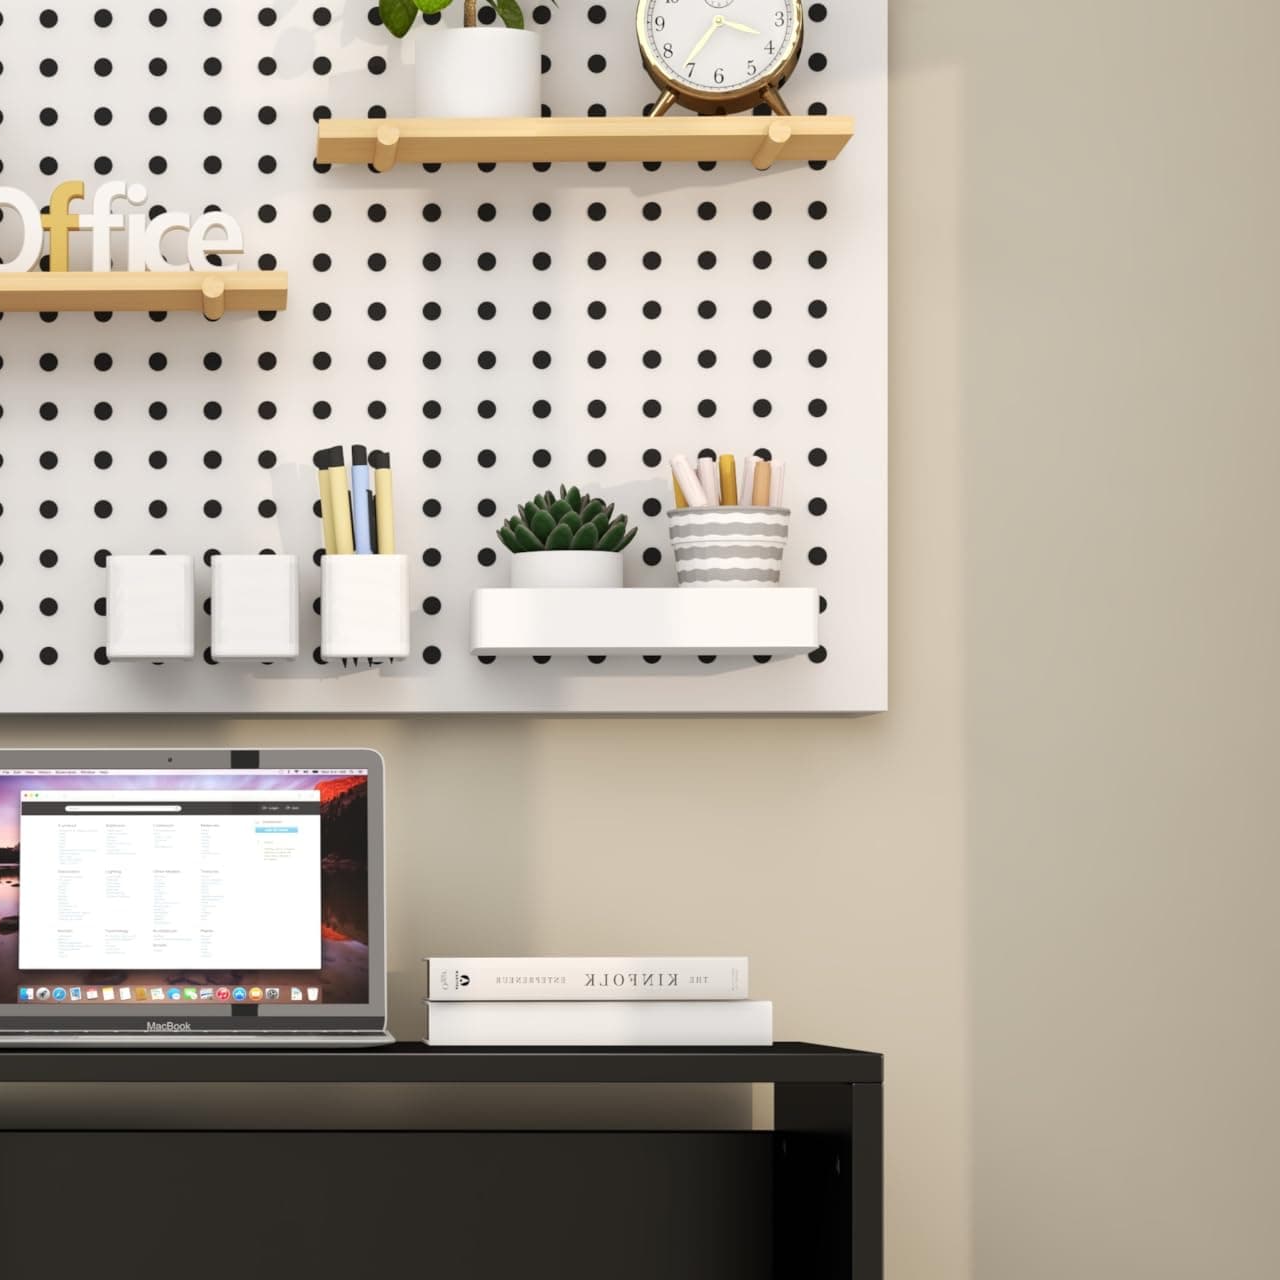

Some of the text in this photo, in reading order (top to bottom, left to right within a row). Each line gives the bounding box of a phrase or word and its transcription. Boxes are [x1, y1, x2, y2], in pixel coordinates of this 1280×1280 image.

[655, 16, 665, 31] 9
[774, 11, 785, 27] 3
[663, 43, 673, 58] 8
[764, 40, 775, 55] 4
[686, 62, 696, 78] 7
[747, 60, 757, 76] 5
[713, 68, 724, 84] 6
[146, 1021, 192, 1033] MacBook
